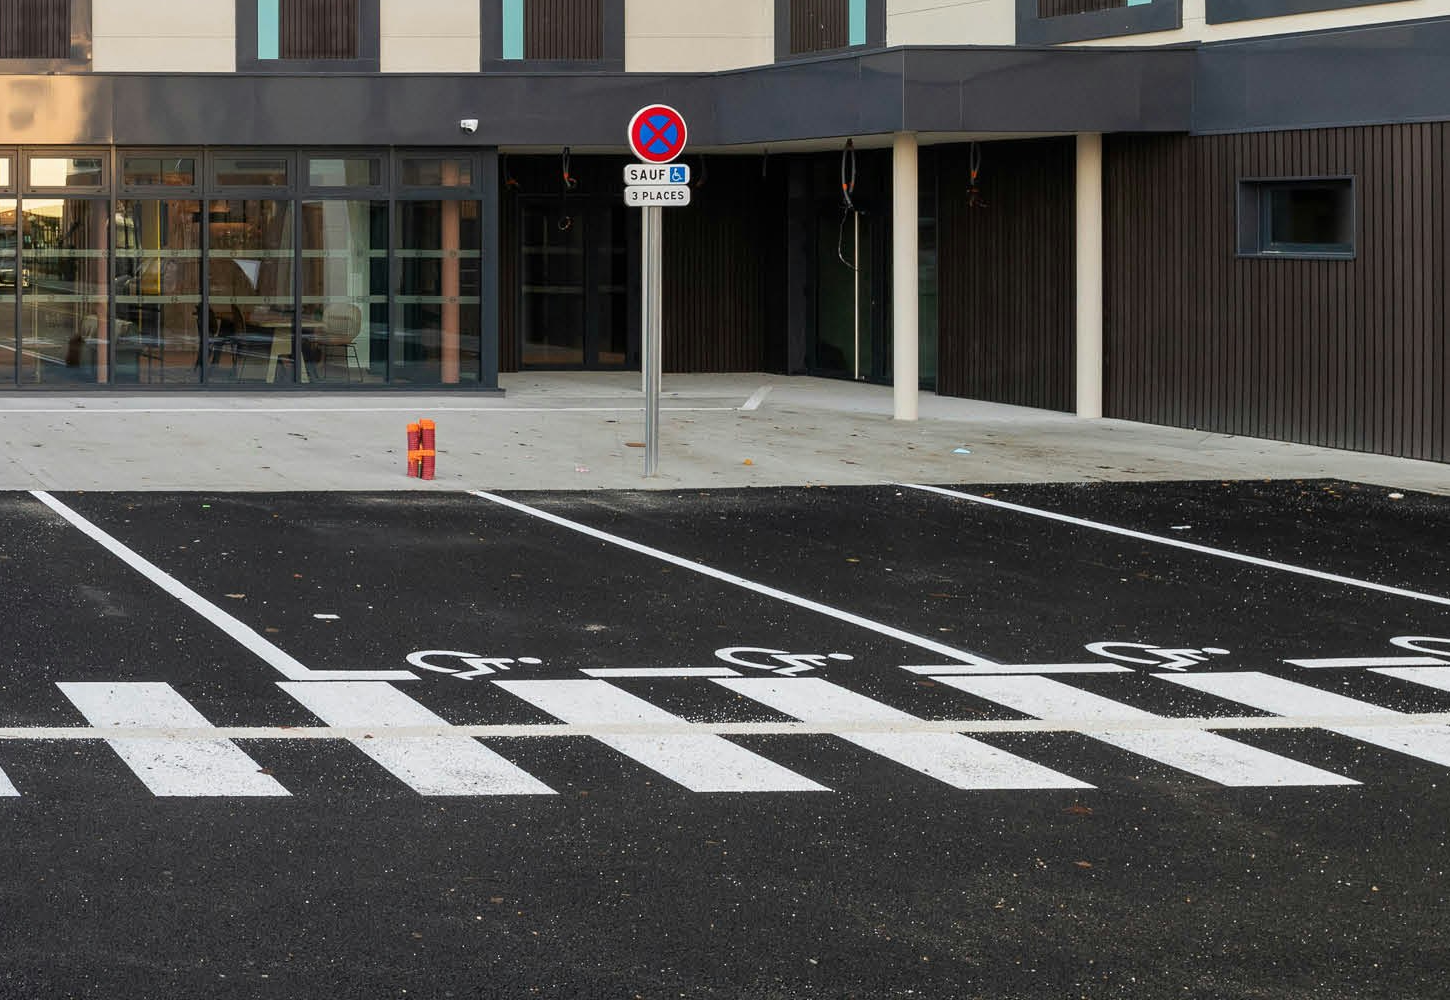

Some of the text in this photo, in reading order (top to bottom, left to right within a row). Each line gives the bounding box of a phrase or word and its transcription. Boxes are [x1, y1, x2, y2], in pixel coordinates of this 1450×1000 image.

[630, 169, 666, 181] SAUF
[632, 191, 684, 201] 3 PLACES
